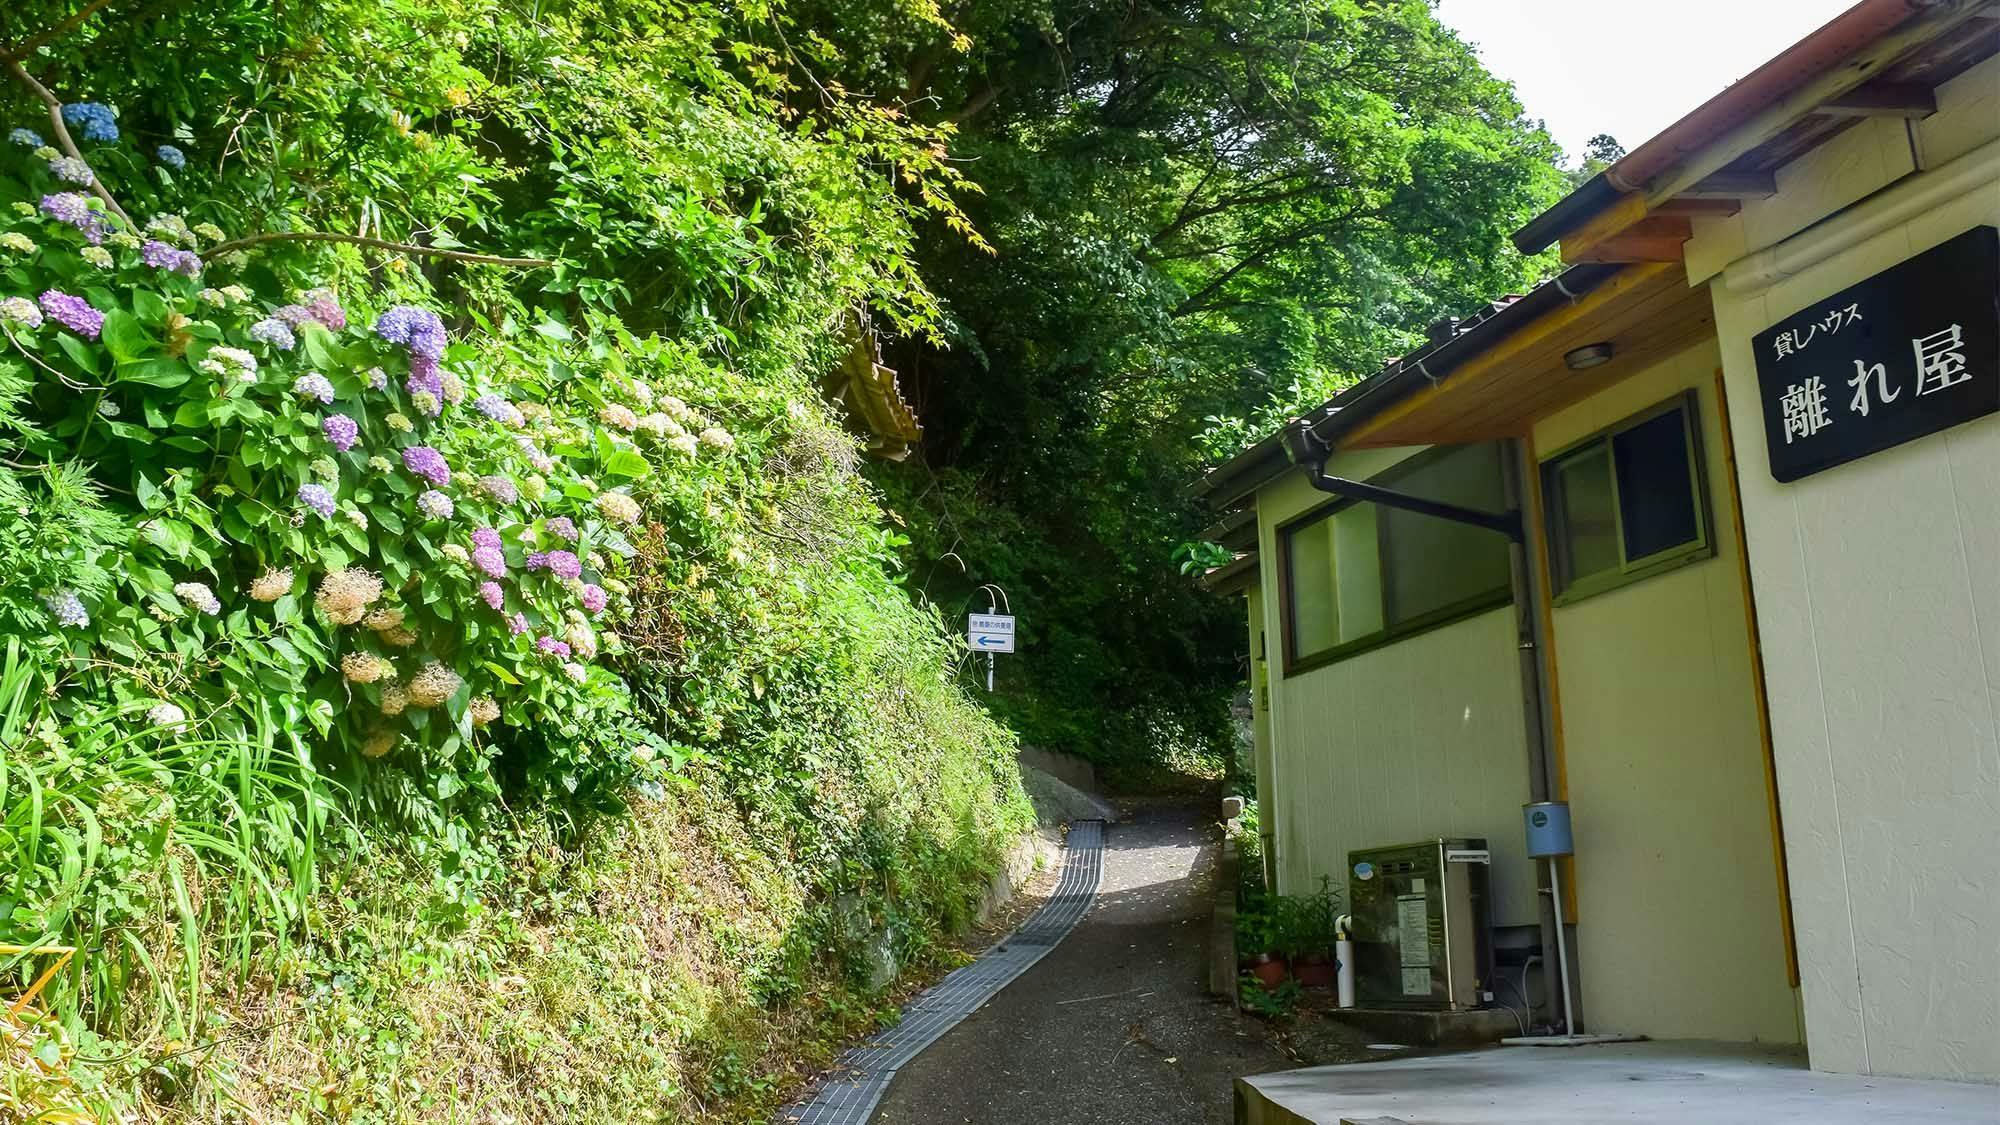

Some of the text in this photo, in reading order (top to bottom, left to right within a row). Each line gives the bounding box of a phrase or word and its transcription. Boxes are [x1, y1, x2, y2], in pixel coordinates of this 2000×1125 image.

[1773, 303, 1863, 361] 貸しハウス
[1779, 323, 1973, 444] 離れ屋
